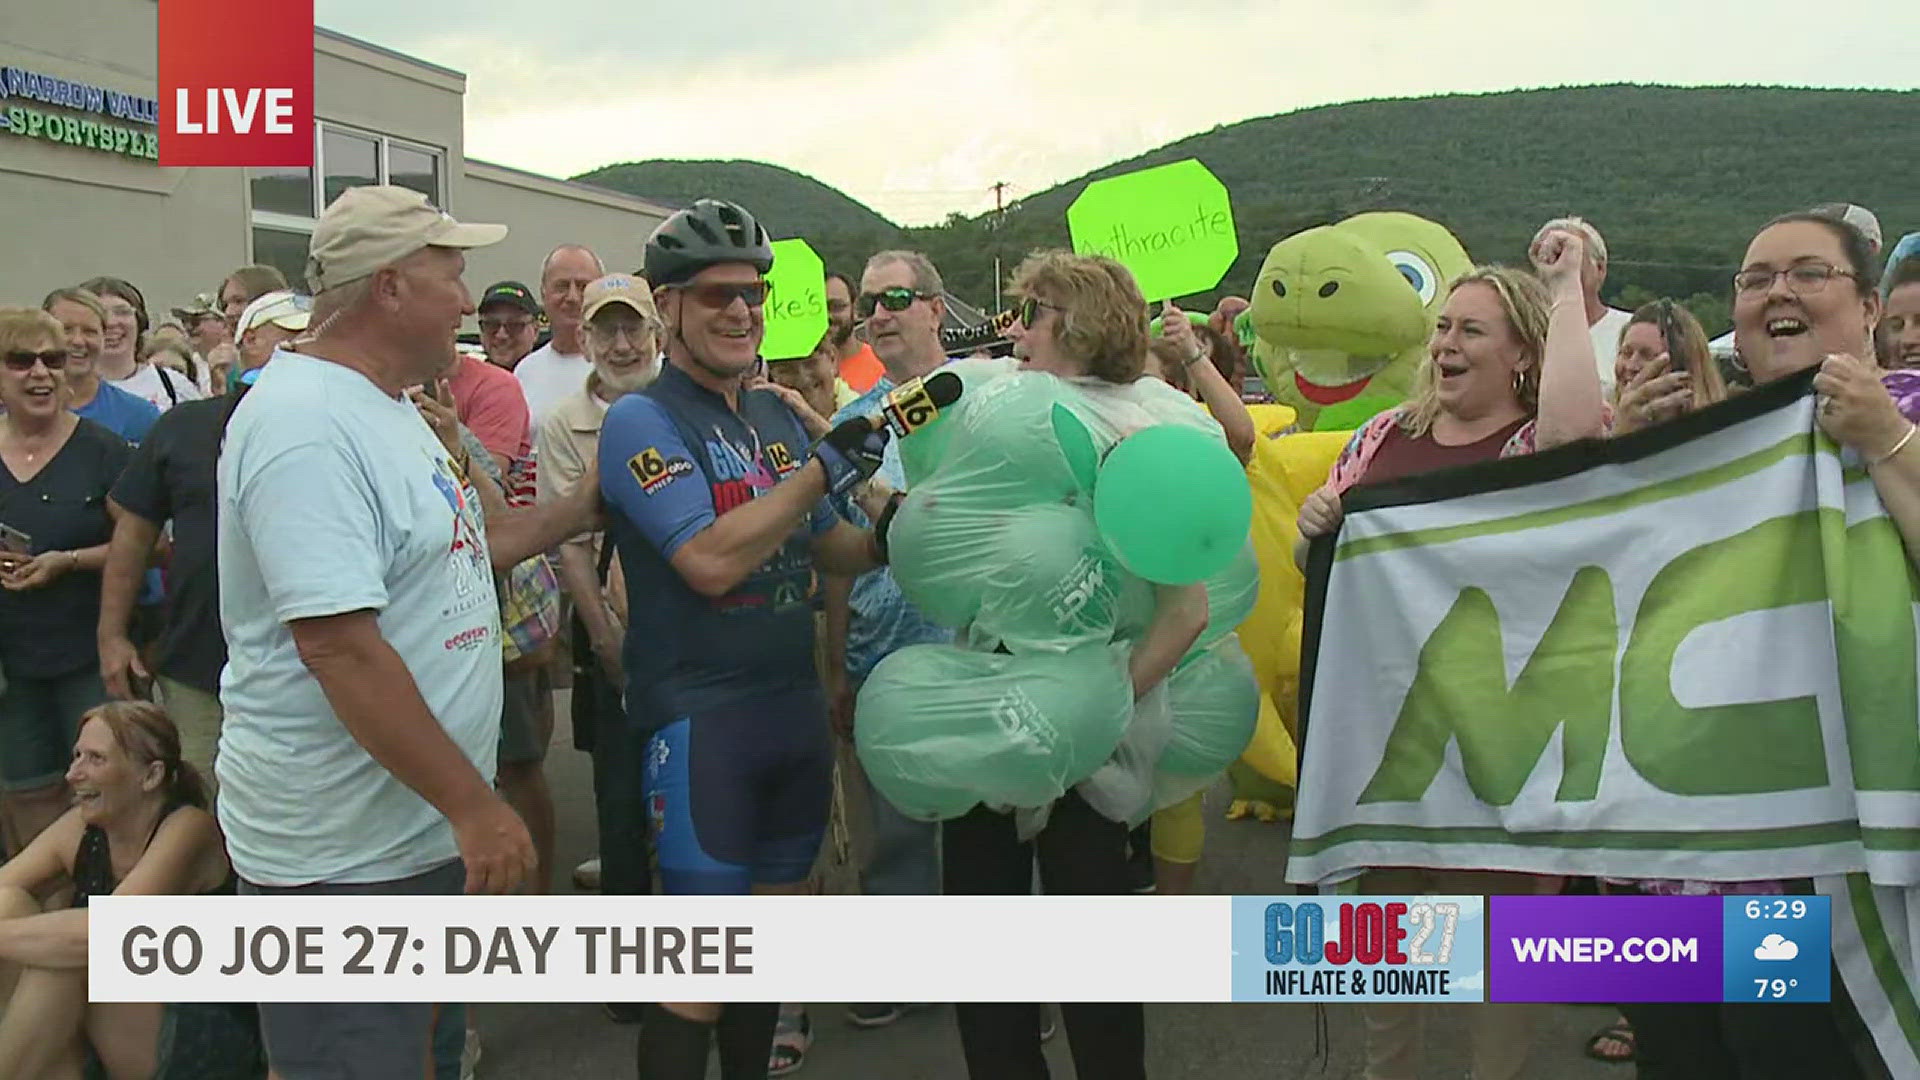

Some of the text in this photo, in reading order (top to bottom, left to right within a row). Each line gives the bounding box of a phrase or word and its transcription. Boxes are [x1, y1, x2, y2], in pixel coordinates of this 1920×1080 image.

[7, 66, 104, 113] NARROW
[899, 391, 934, 425] 16
[630, 452, 675, 483] 16
[769, 445, 791, 468] 16
